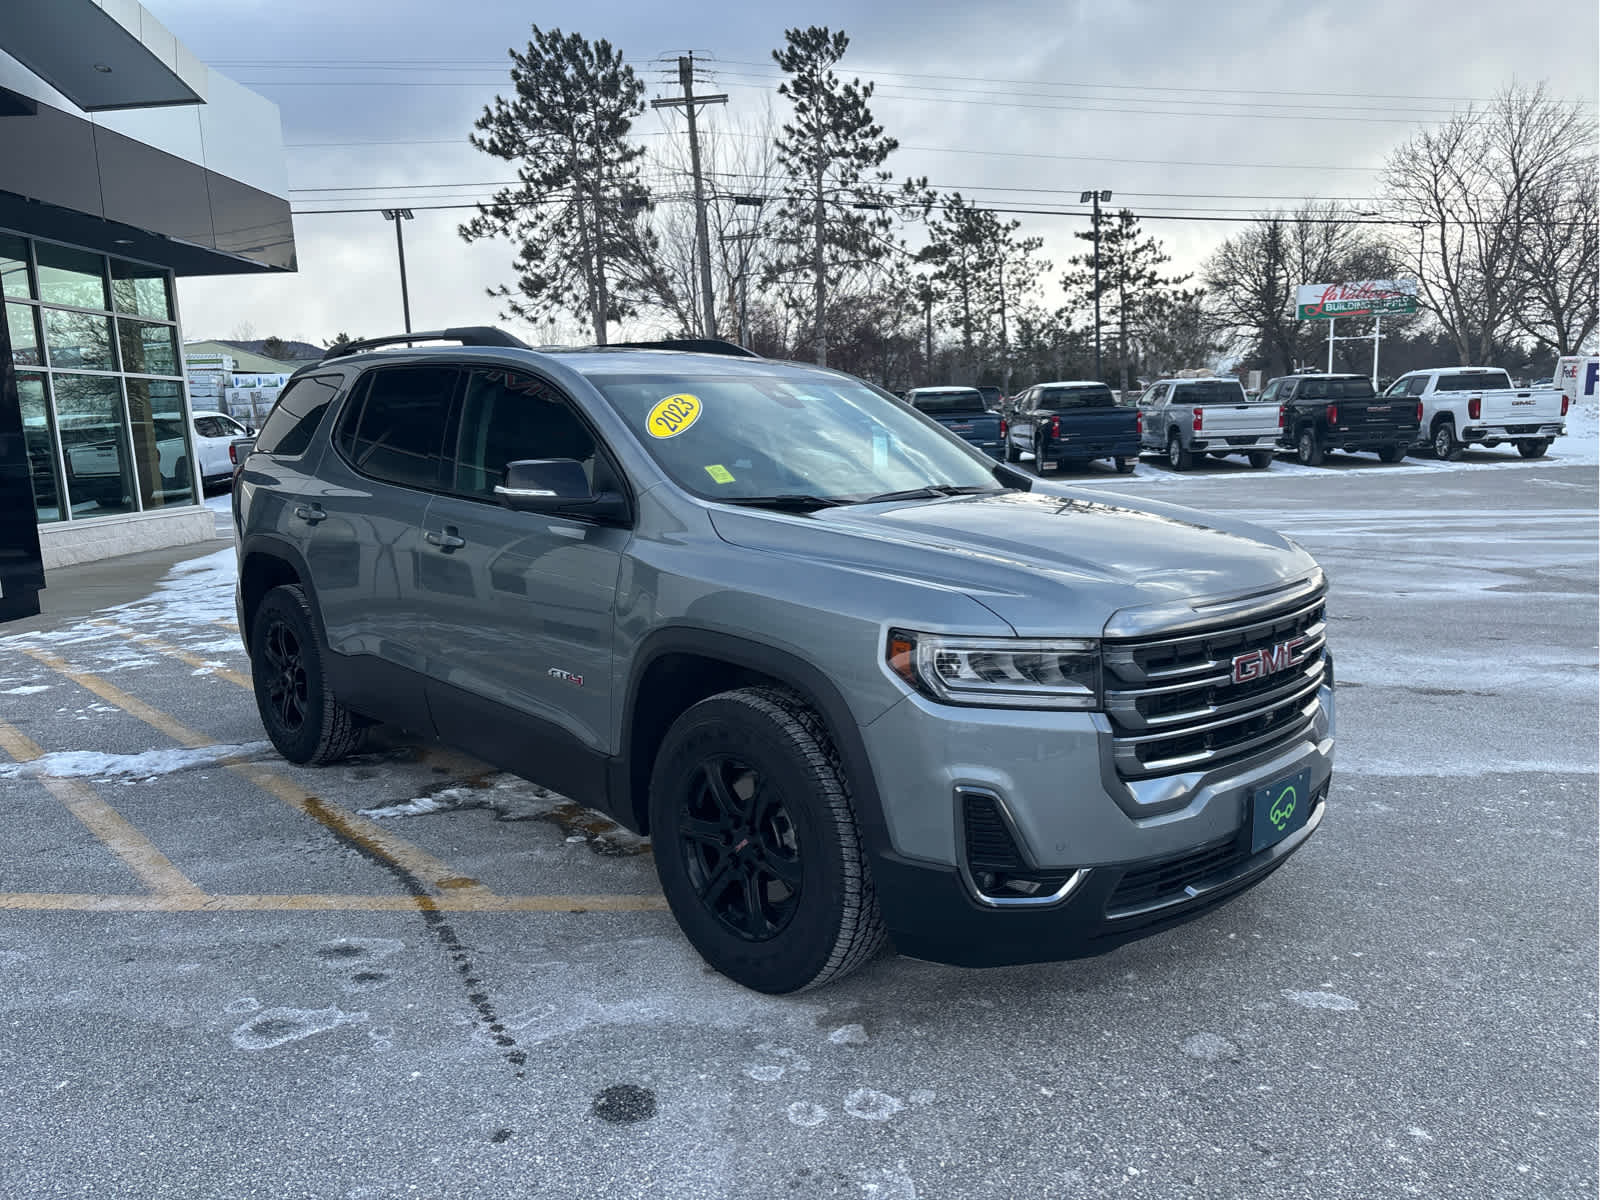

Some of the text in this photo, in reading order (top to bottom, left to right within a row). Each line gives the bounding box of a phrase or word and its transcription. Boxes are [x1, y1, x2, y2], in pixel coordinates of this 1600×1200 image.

[1326, 301, 1371, 312] BUILDING
[1563, 365, 1577, 378] FedE
[655, 397, 694, 432] 2023
[1232, 637, 1305, 684] GMC
